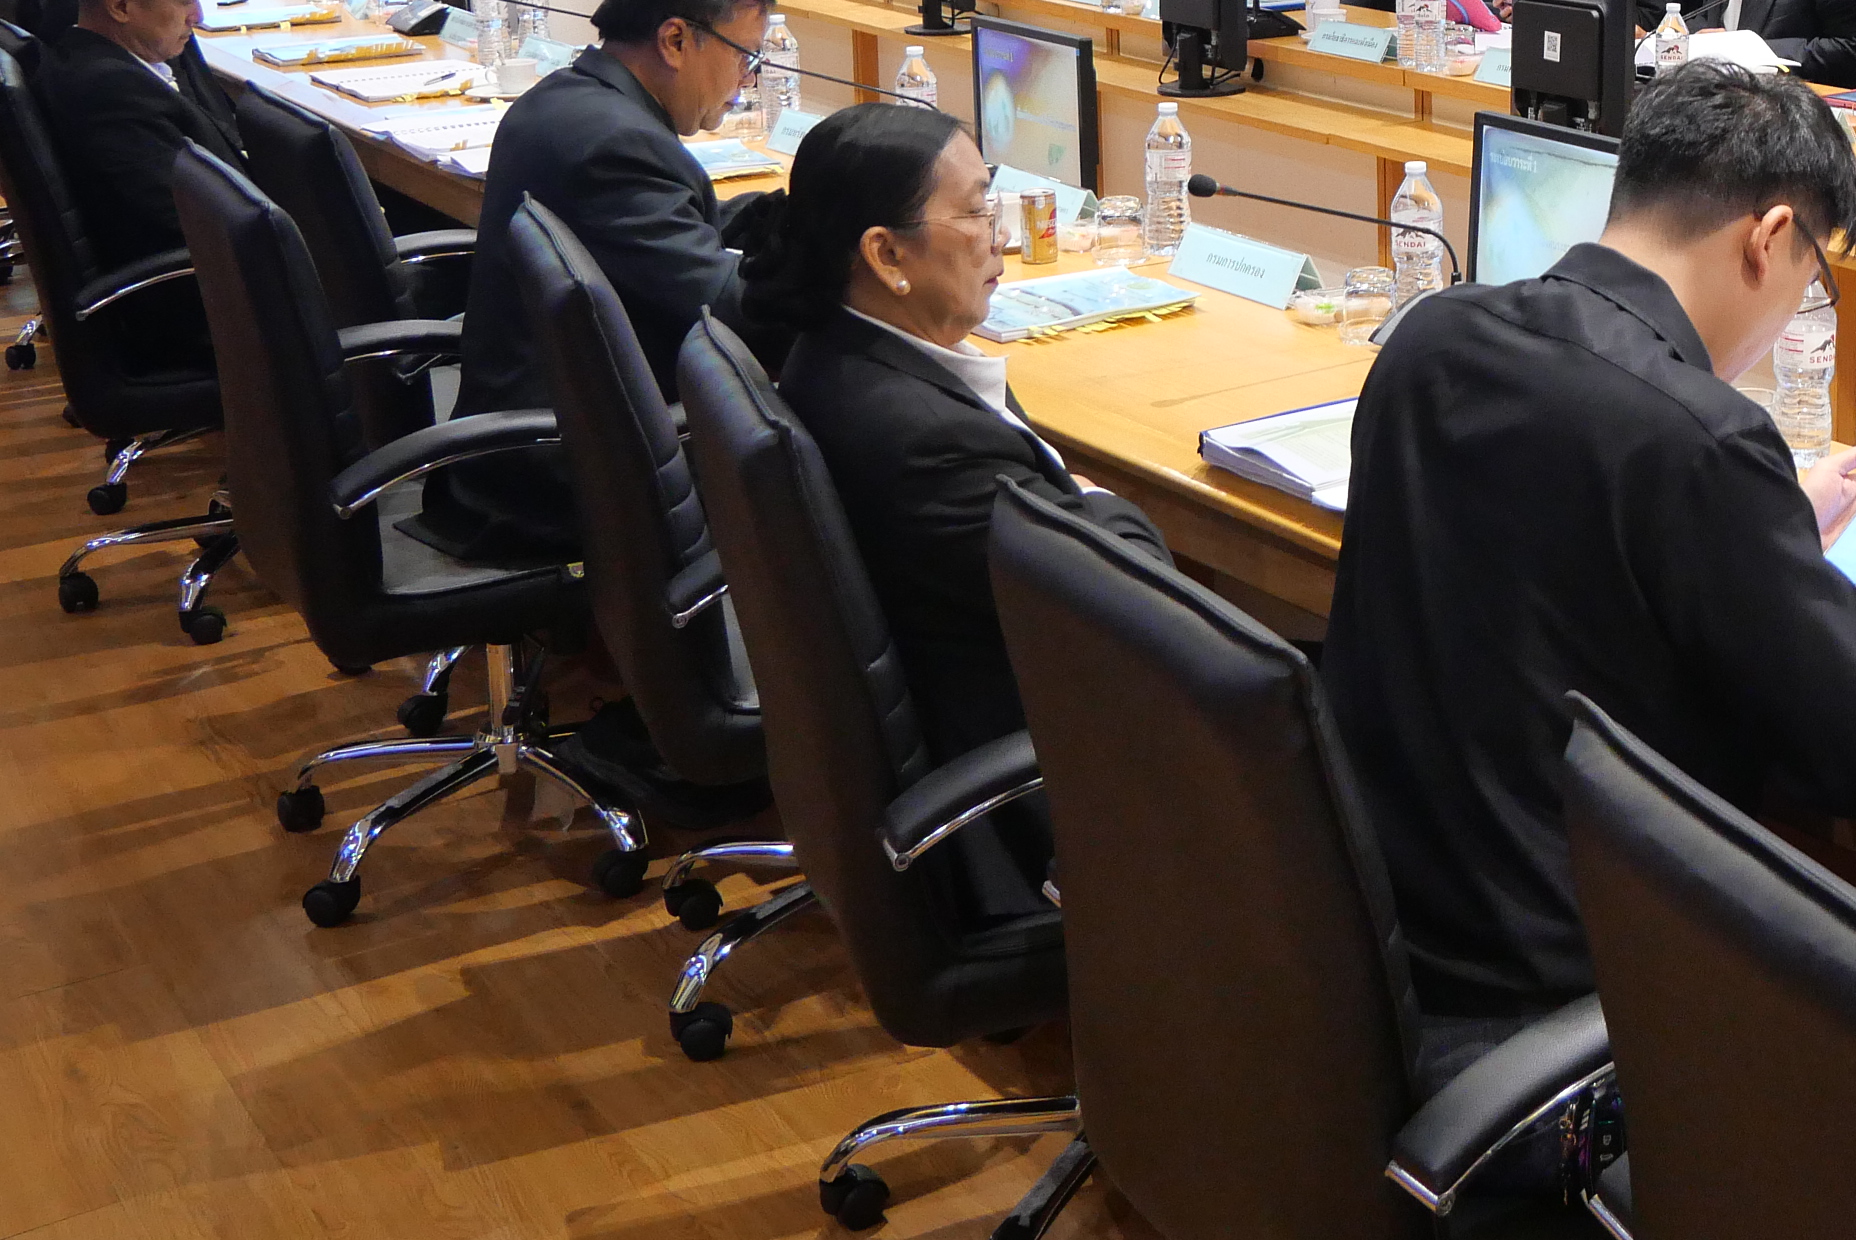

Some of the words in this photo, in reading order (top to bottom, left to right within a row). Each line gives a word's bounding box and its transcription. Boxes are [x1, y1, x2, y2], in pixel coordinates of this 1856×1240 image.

[1206, 253, 1266, 279] กรมการปกครอง
